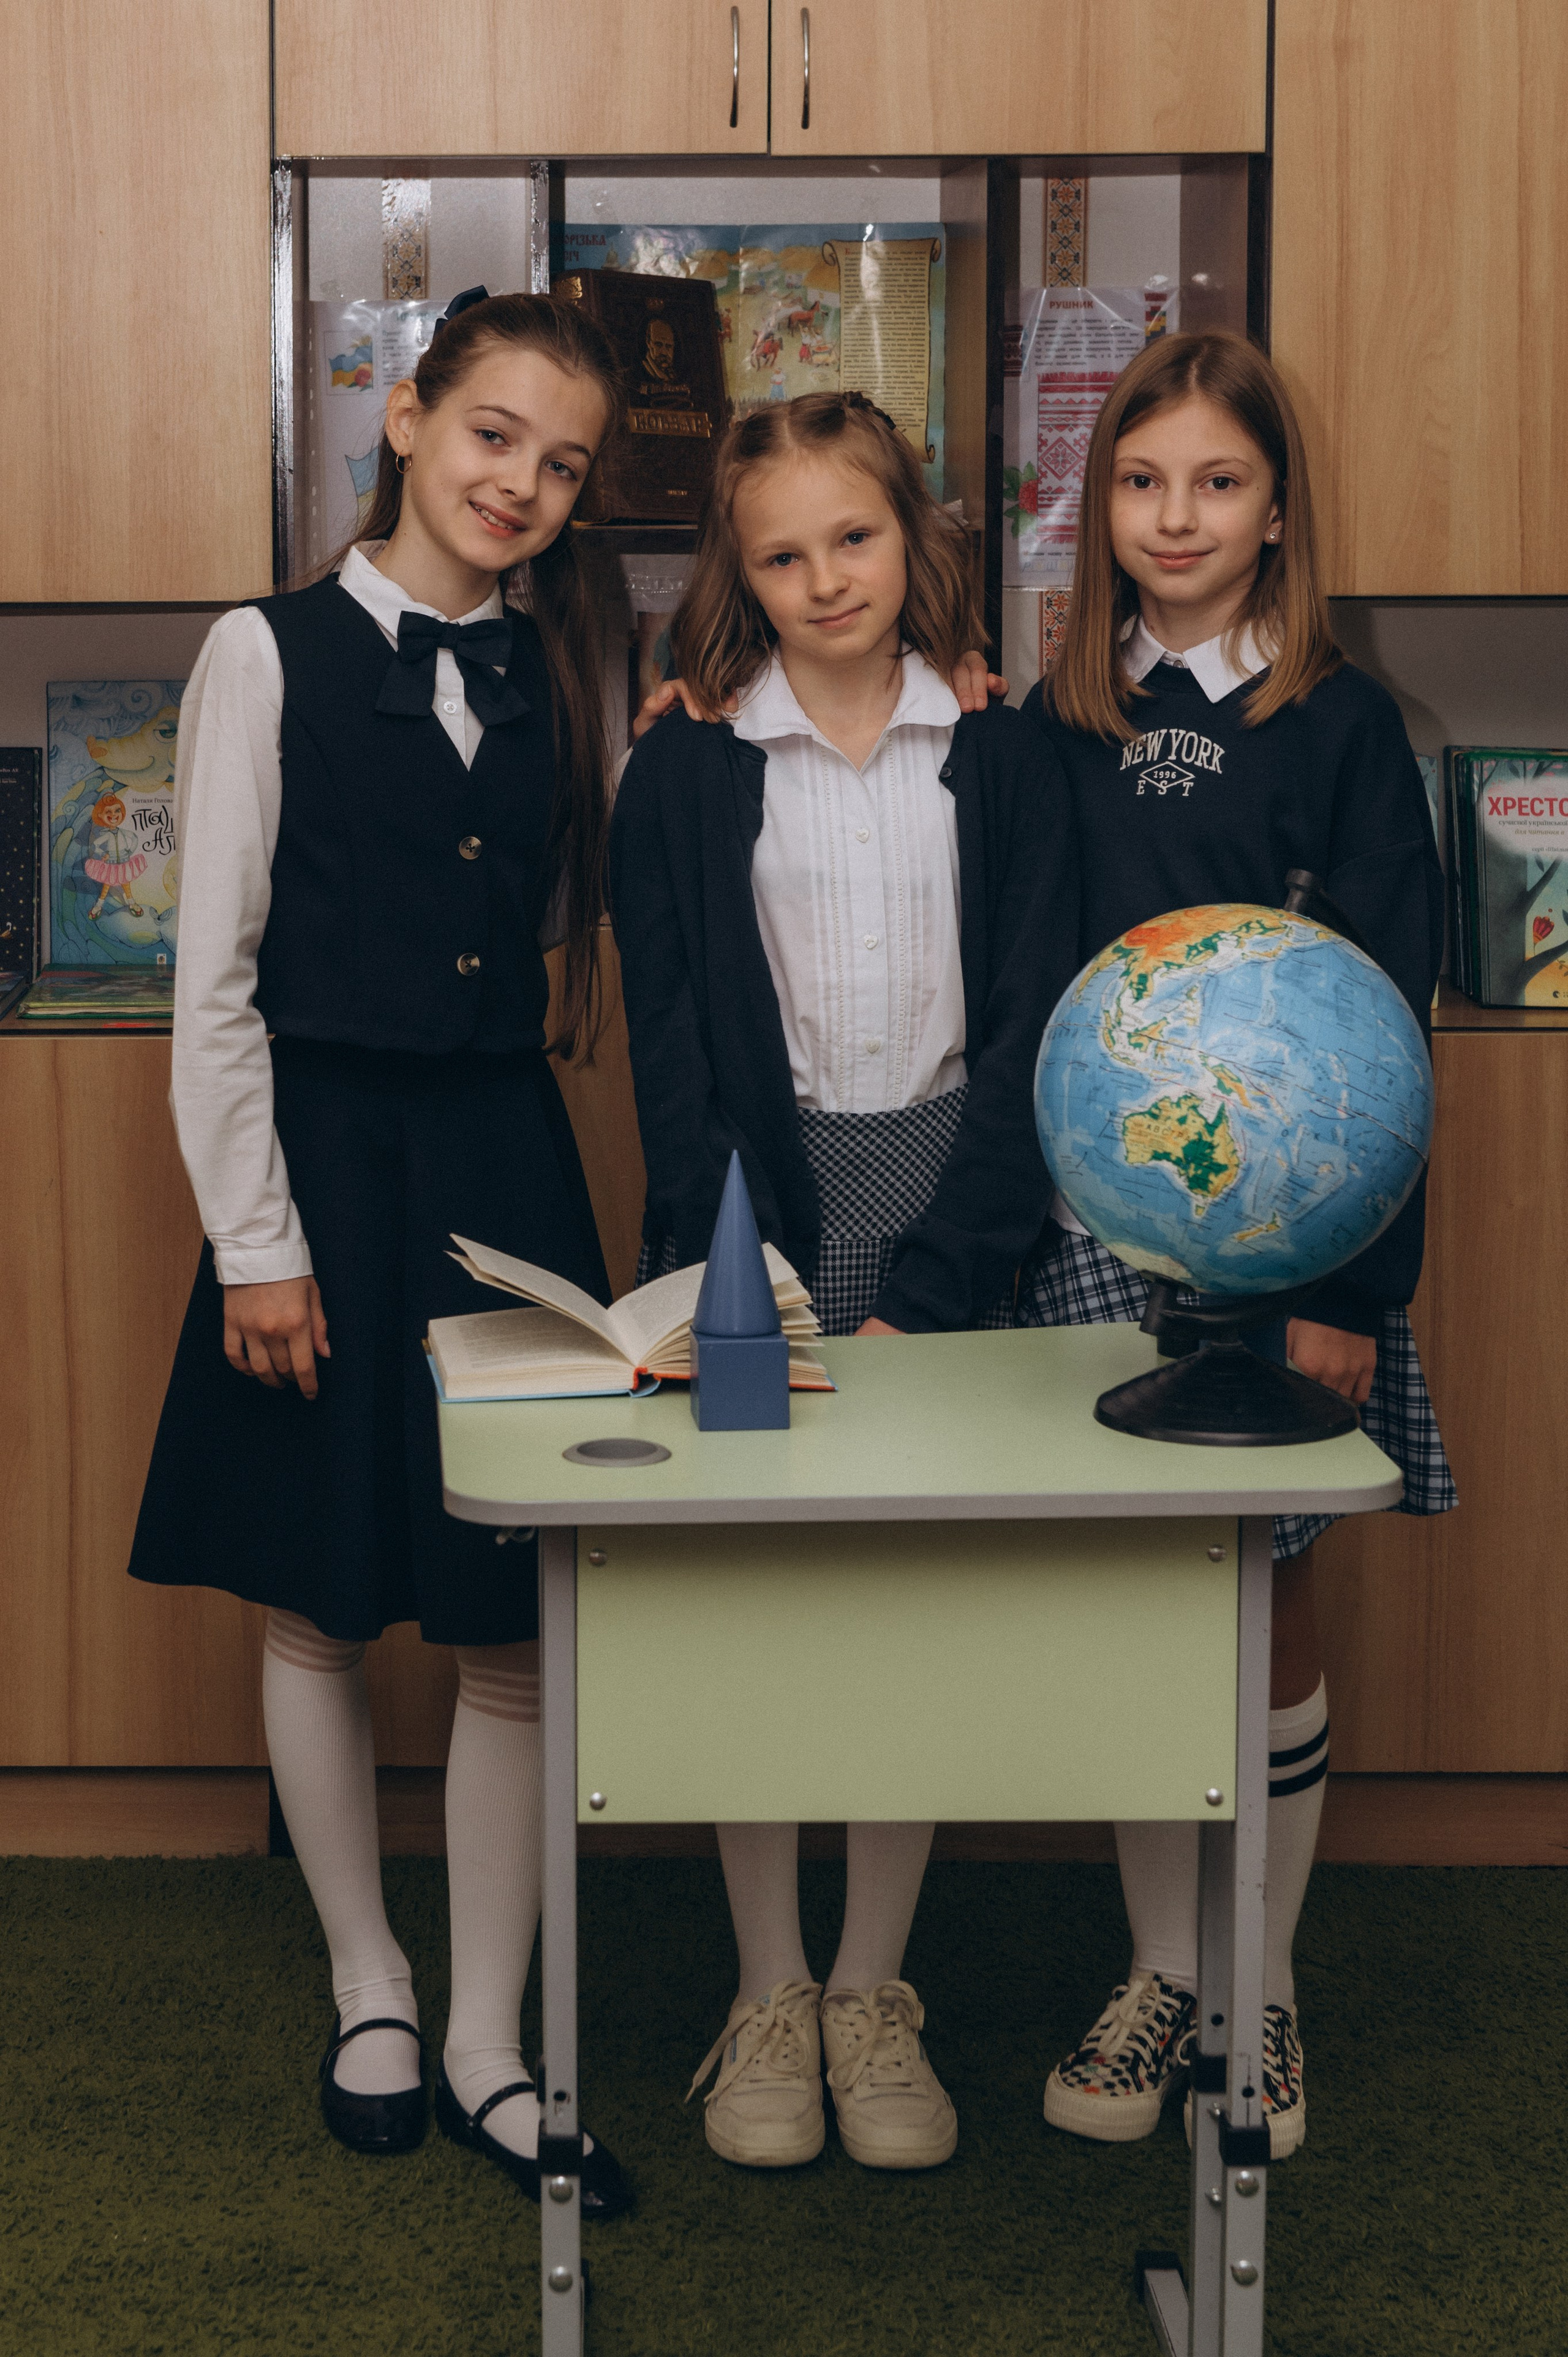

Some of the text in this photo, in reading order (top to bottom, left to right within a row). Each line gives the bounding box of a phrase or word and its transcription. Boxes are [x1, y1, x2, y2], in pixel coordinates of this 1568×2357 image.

[1119, 728, 1226, 774] NEW YORK
[1153, 770, 1177, 779] 1996
[1487, 796, 1568, 817] ХРЕСТО
